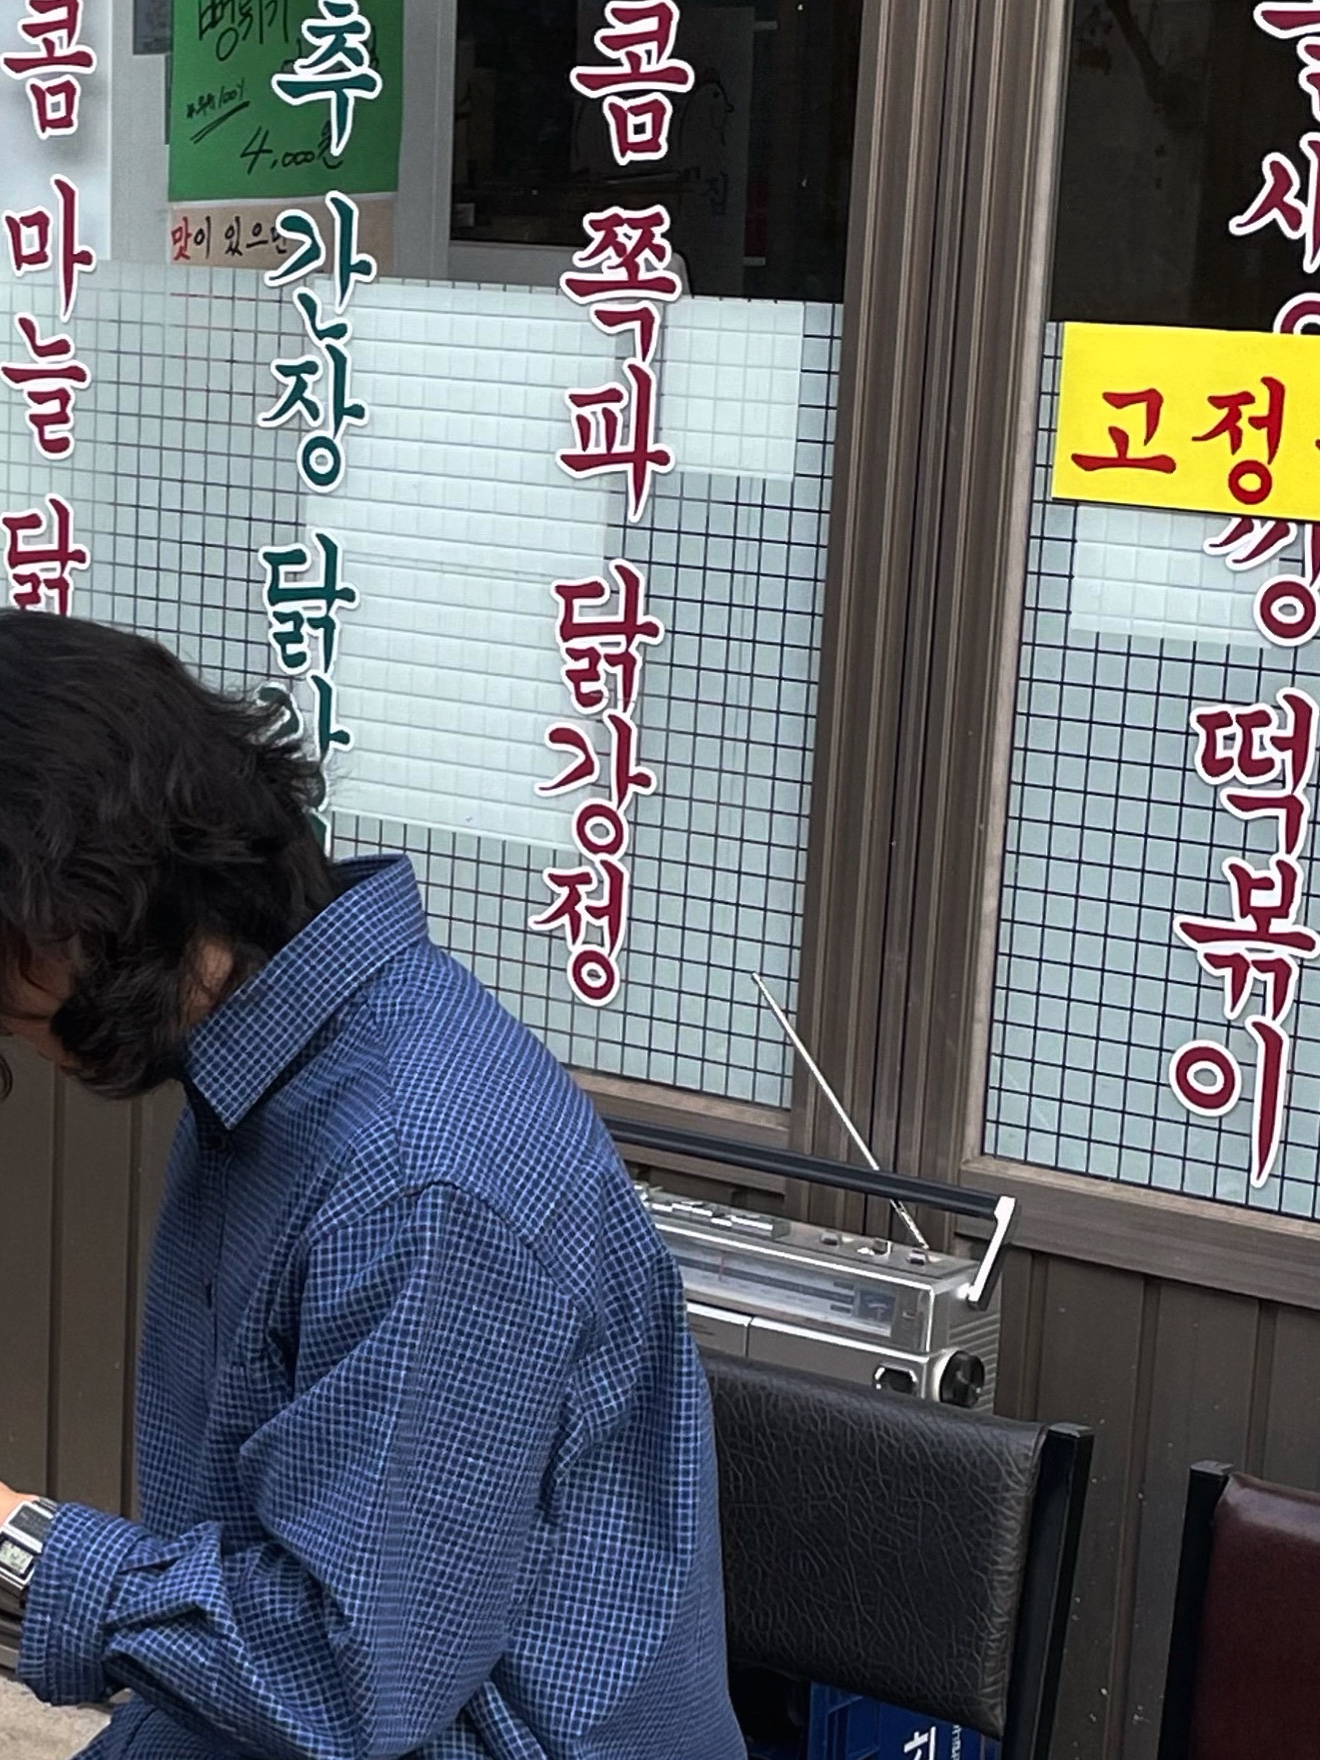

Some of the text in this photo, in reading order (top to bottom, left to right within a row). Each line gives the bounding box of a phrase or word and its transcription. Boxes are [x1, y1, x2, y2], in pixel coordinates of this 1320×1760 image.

[0, 178, 92, 455] 마늘
[171, 215, 212, 261] 맛이
[260, 196, 372, 486] 간장
[535, 2, 690, 1001] 콤 쪽파 닭강정
[1070, 376, 1320, 506] 고정
[1173, 692, 1320, 1183] 떡볶이
